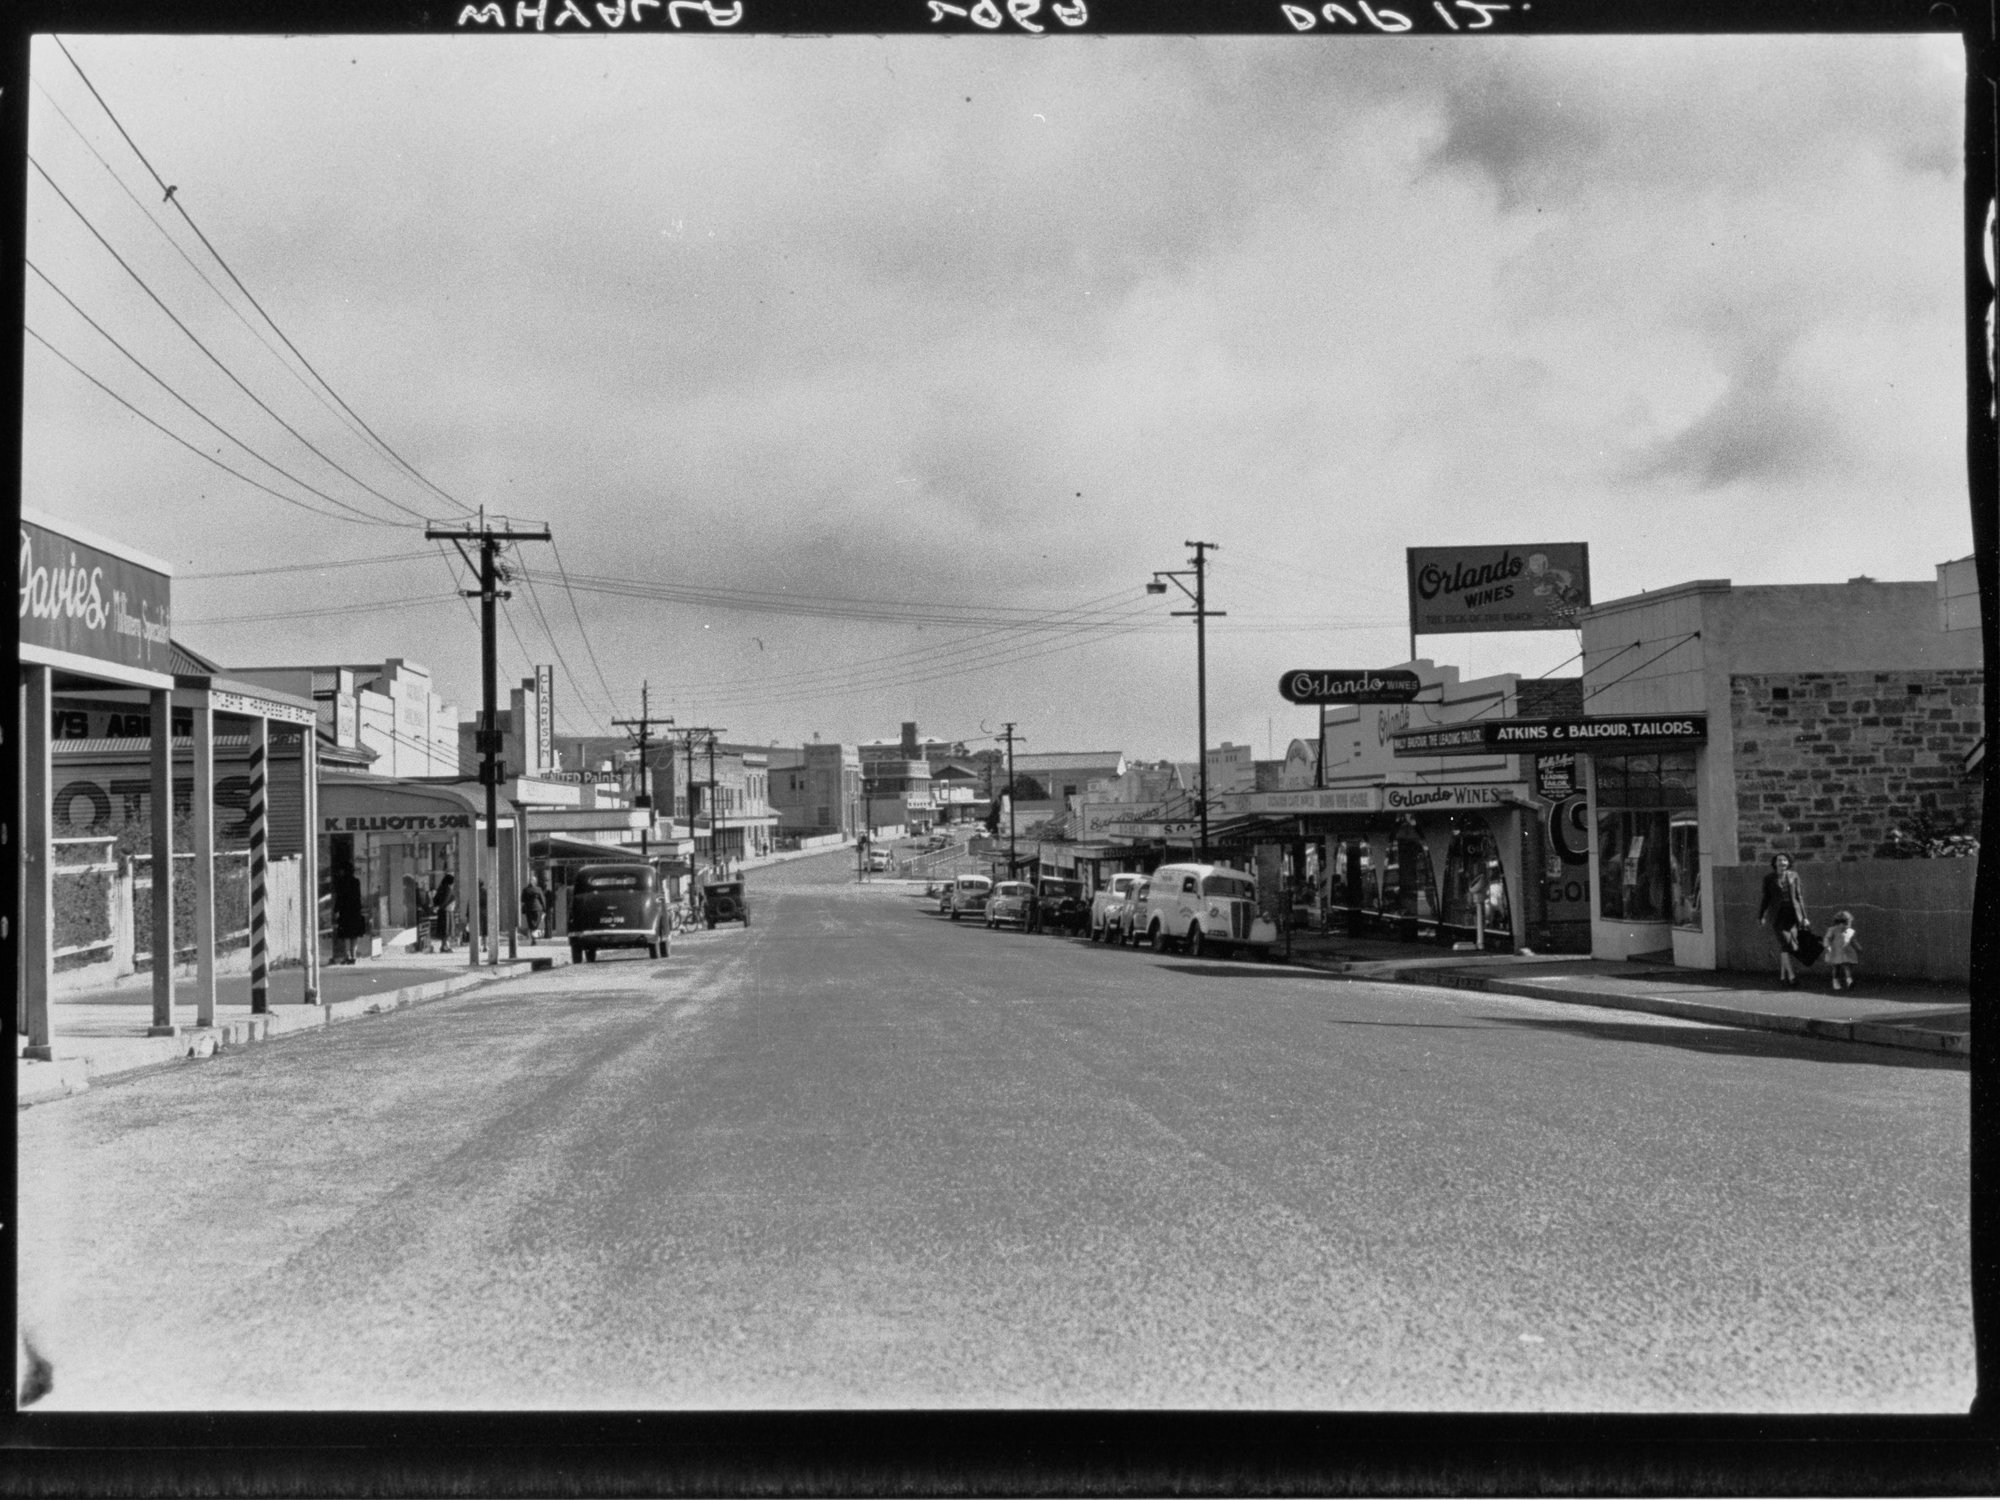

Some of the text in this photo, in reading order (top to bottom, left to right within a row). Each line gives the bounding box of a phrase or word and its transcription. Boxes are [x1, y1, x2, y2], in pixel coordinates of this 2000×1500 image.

[1418, 550, 1524, 600] Orlando
[1464, 584, 1514, 608] WINES
[1292, 671, 1418, 697] Orlando WINES
[1497, 727, 1548, 740] ATKINS
[1552, 727, 1564, 738] &
[1569, 724, 1631, 738] BALFOUR,
[584, 771, 621, 784] Paints
[1388, 786, 1453, 808] Orlando
[1453, 786, 1500, 804] WINES
[325, 817, 343, 831] K.
[1547, 879, 1590, 903] GO
